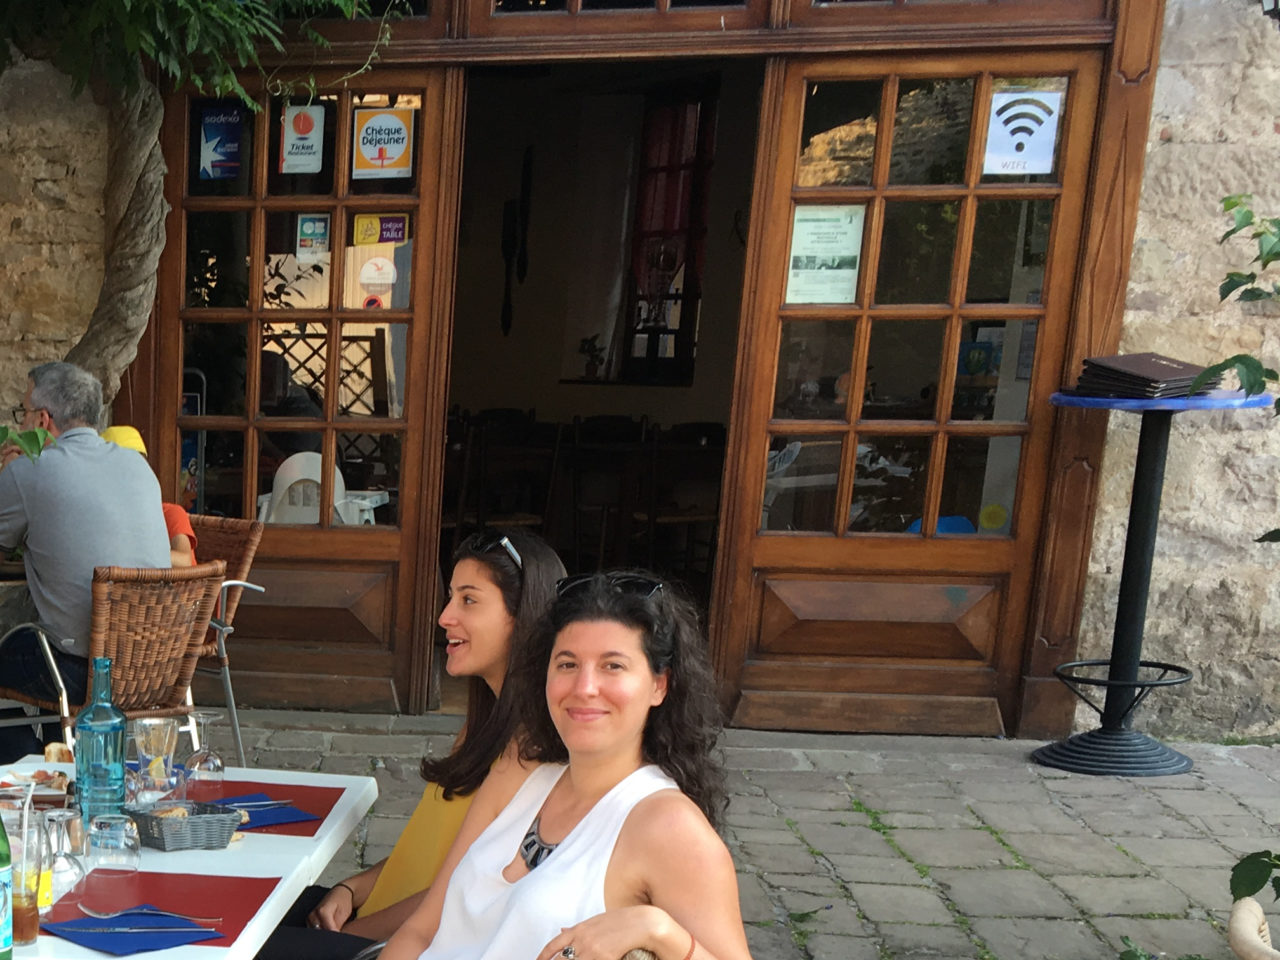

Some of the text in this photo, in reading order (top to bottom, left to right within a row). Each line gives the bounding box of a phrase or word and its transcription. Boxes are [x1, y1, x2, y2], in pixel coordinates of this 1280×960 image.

[205, 112, 240, 124] sodexo
[365, 125, 403, 137] Chèque
[361, 135, 407, 147] Déjeuner
[290, 143, 314, 151] Ticket
[1001, 161, 1027, 170] WIFI
[382, 229, 403, 239] TABLE
